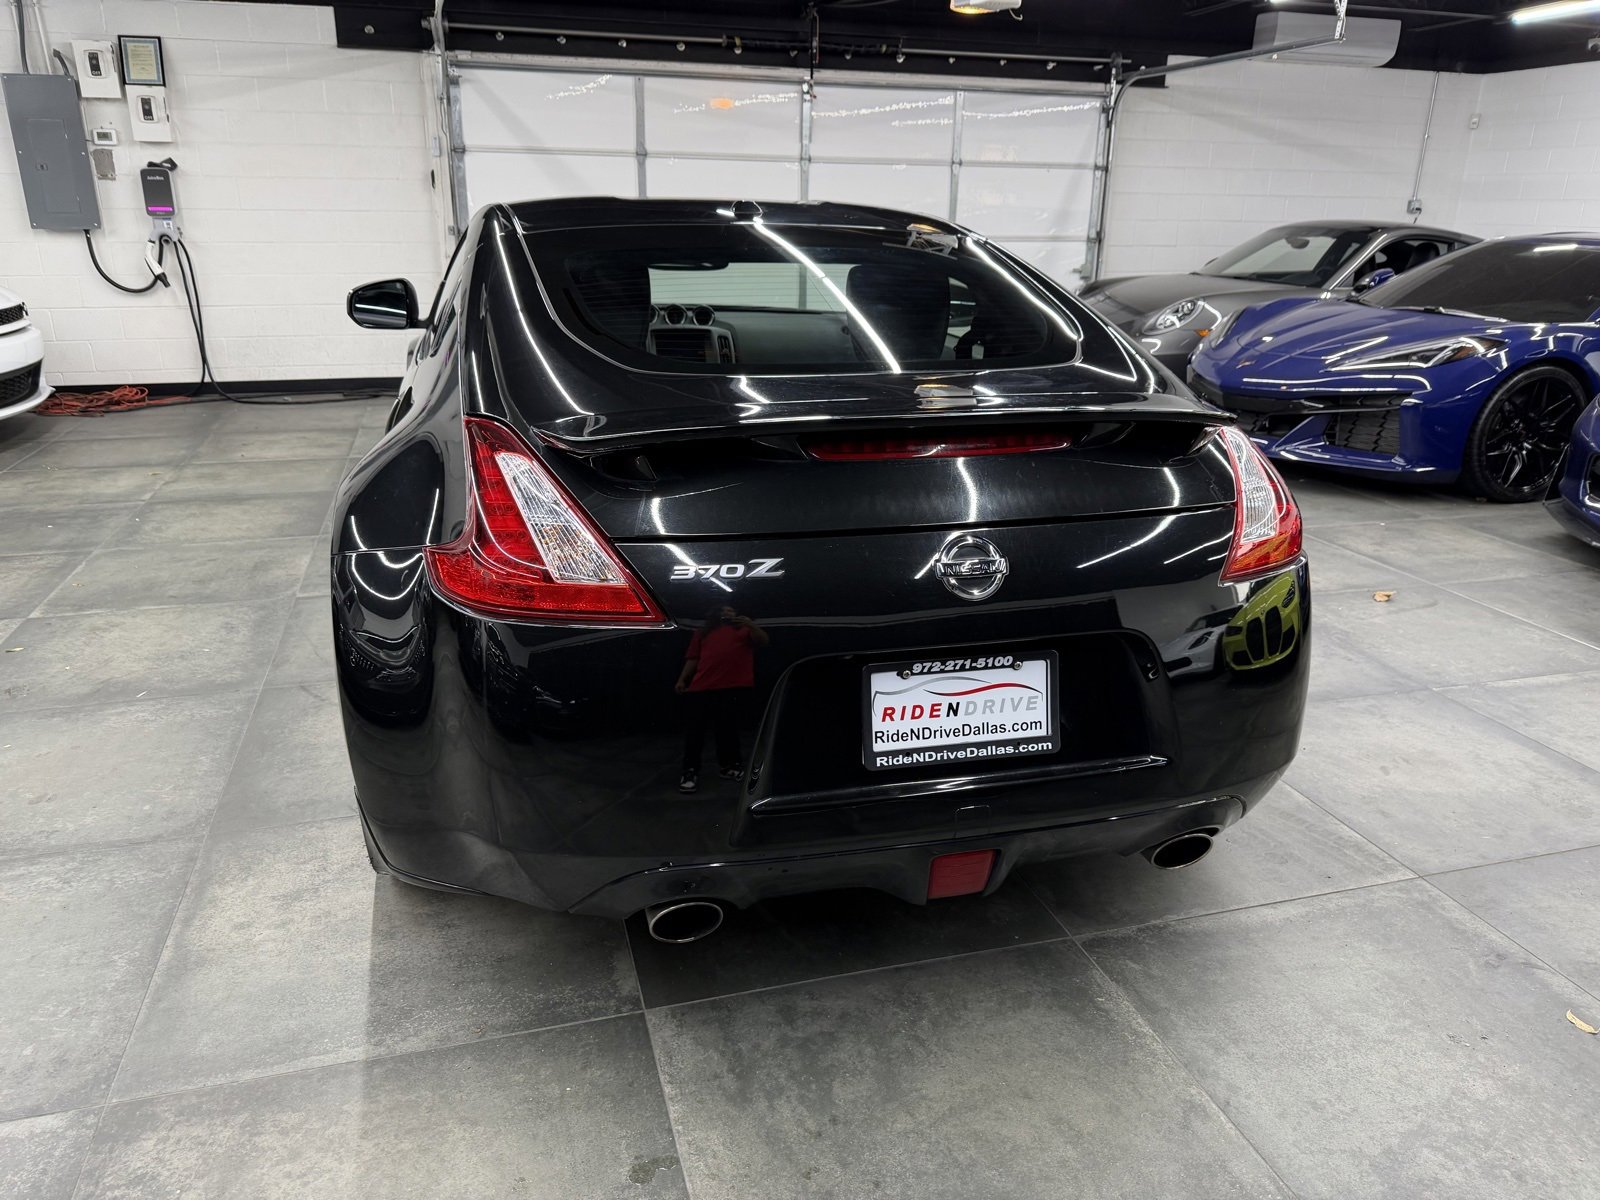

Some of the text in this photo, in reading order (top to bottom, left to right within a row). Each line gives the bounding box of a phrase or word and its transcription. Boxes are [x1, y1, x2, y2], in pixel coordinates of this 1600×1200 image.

[670, 558, 785, 580] 370Z
[944, 560, 1001, 576] NISSAN
[911, 655, 1014, 674] 972-271-5100
[881, 695, 1039, 722] RIDENDRIVE
[874, 720, 1043, 744] RideNDriveDallas.com
[876, 741, 1053, 767] RideNDriveDallas.com
